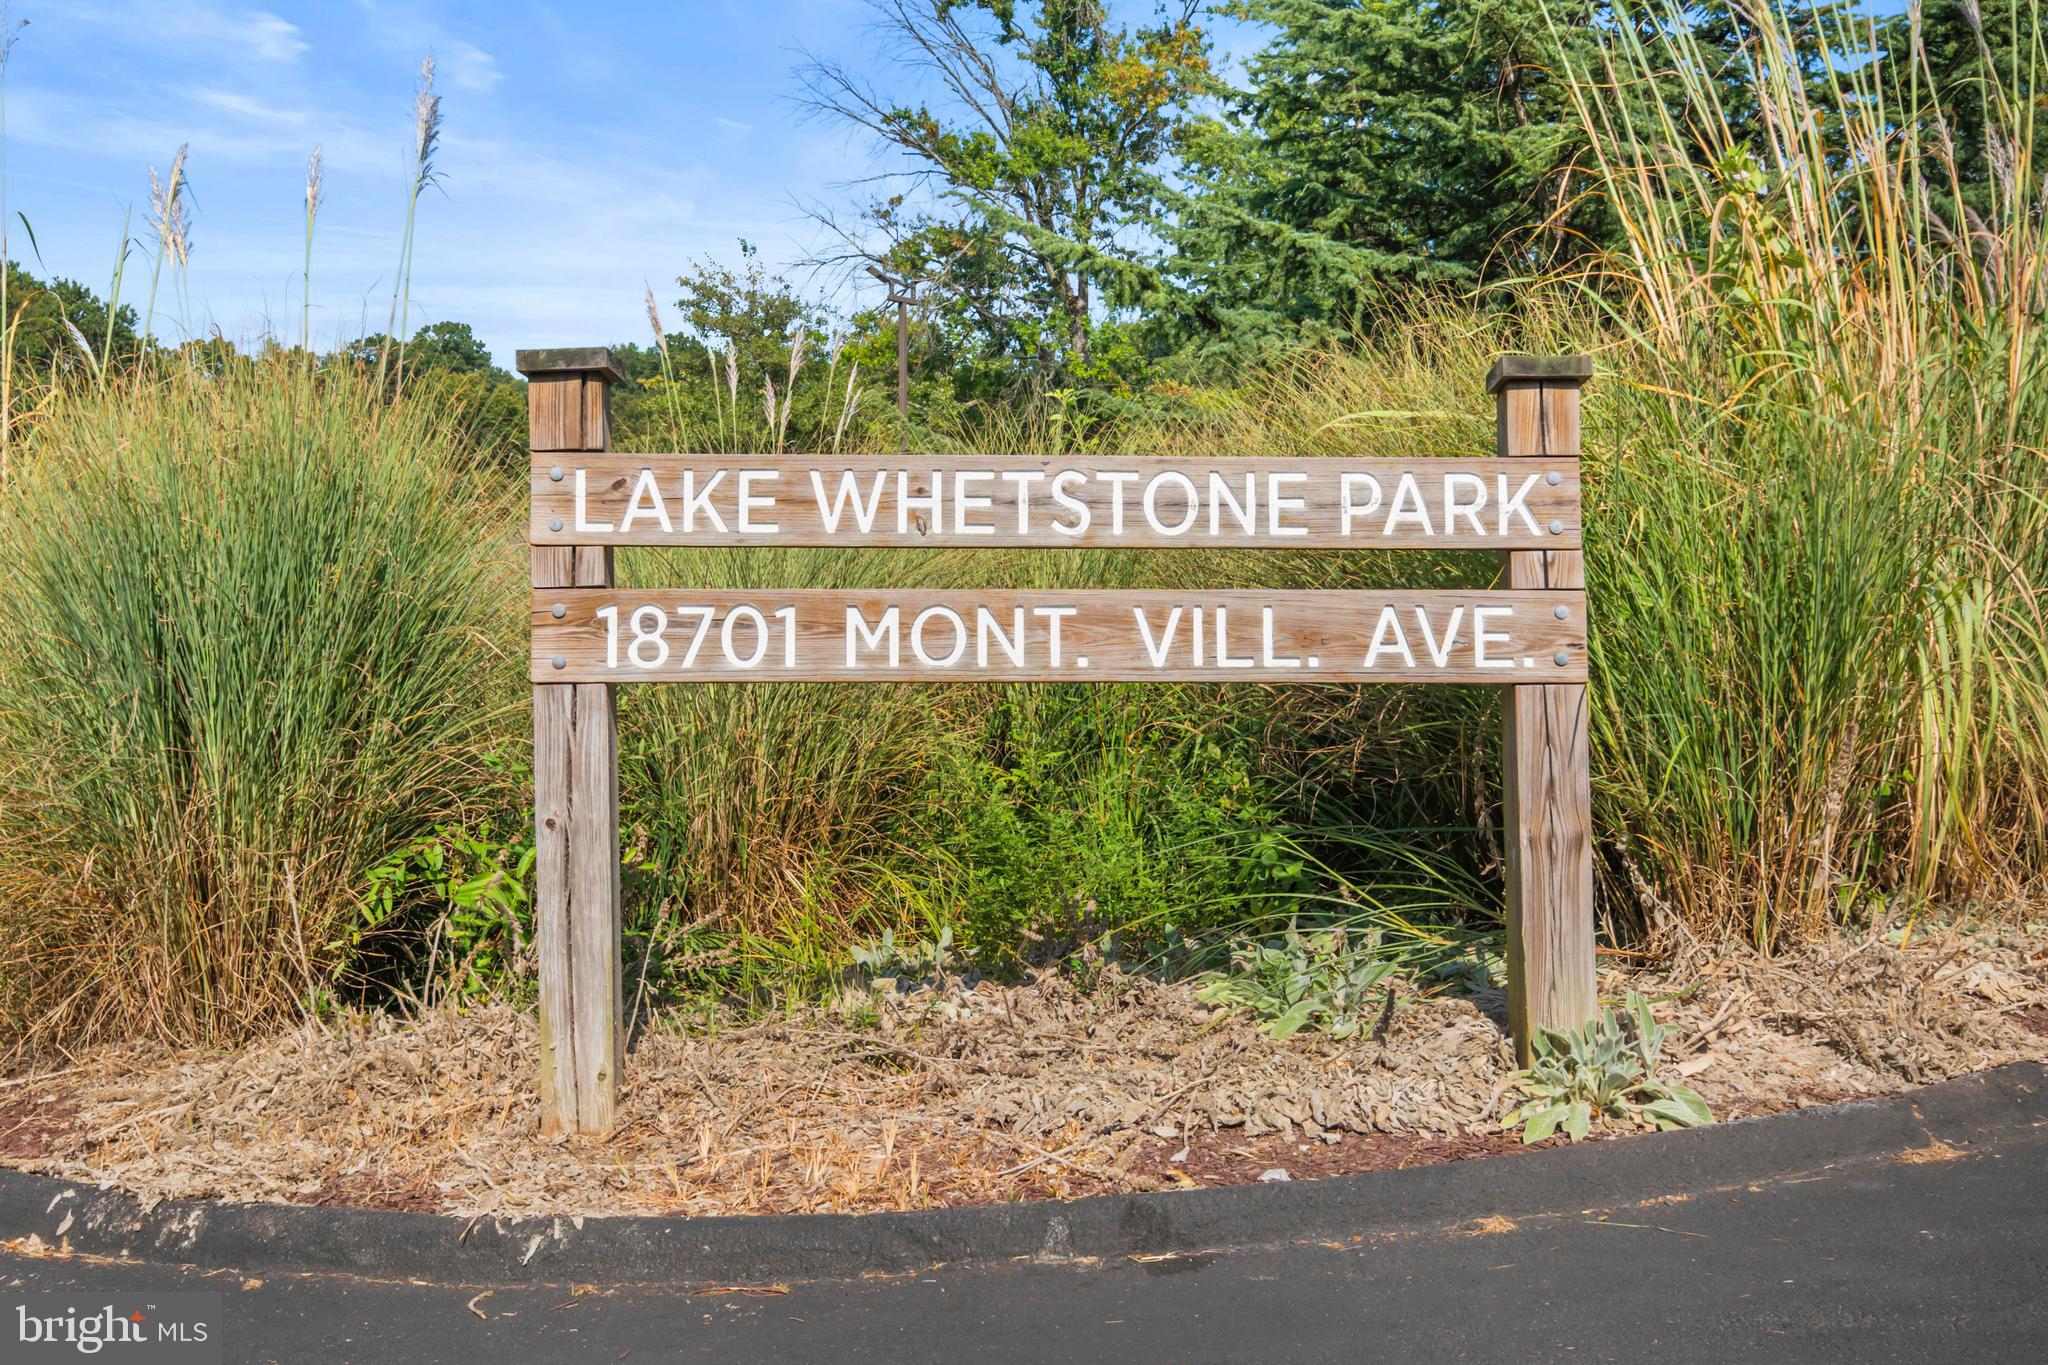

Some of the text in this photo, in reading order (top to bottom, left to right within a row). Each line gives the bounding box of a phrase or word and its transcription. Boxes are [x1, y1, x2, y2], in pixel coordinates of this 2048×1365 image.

[575, 468, 1543, 537] LAKE WHETSTONE PARK
[595, 604, 1535, 669] 18701 MONT. VILL. AVE.
